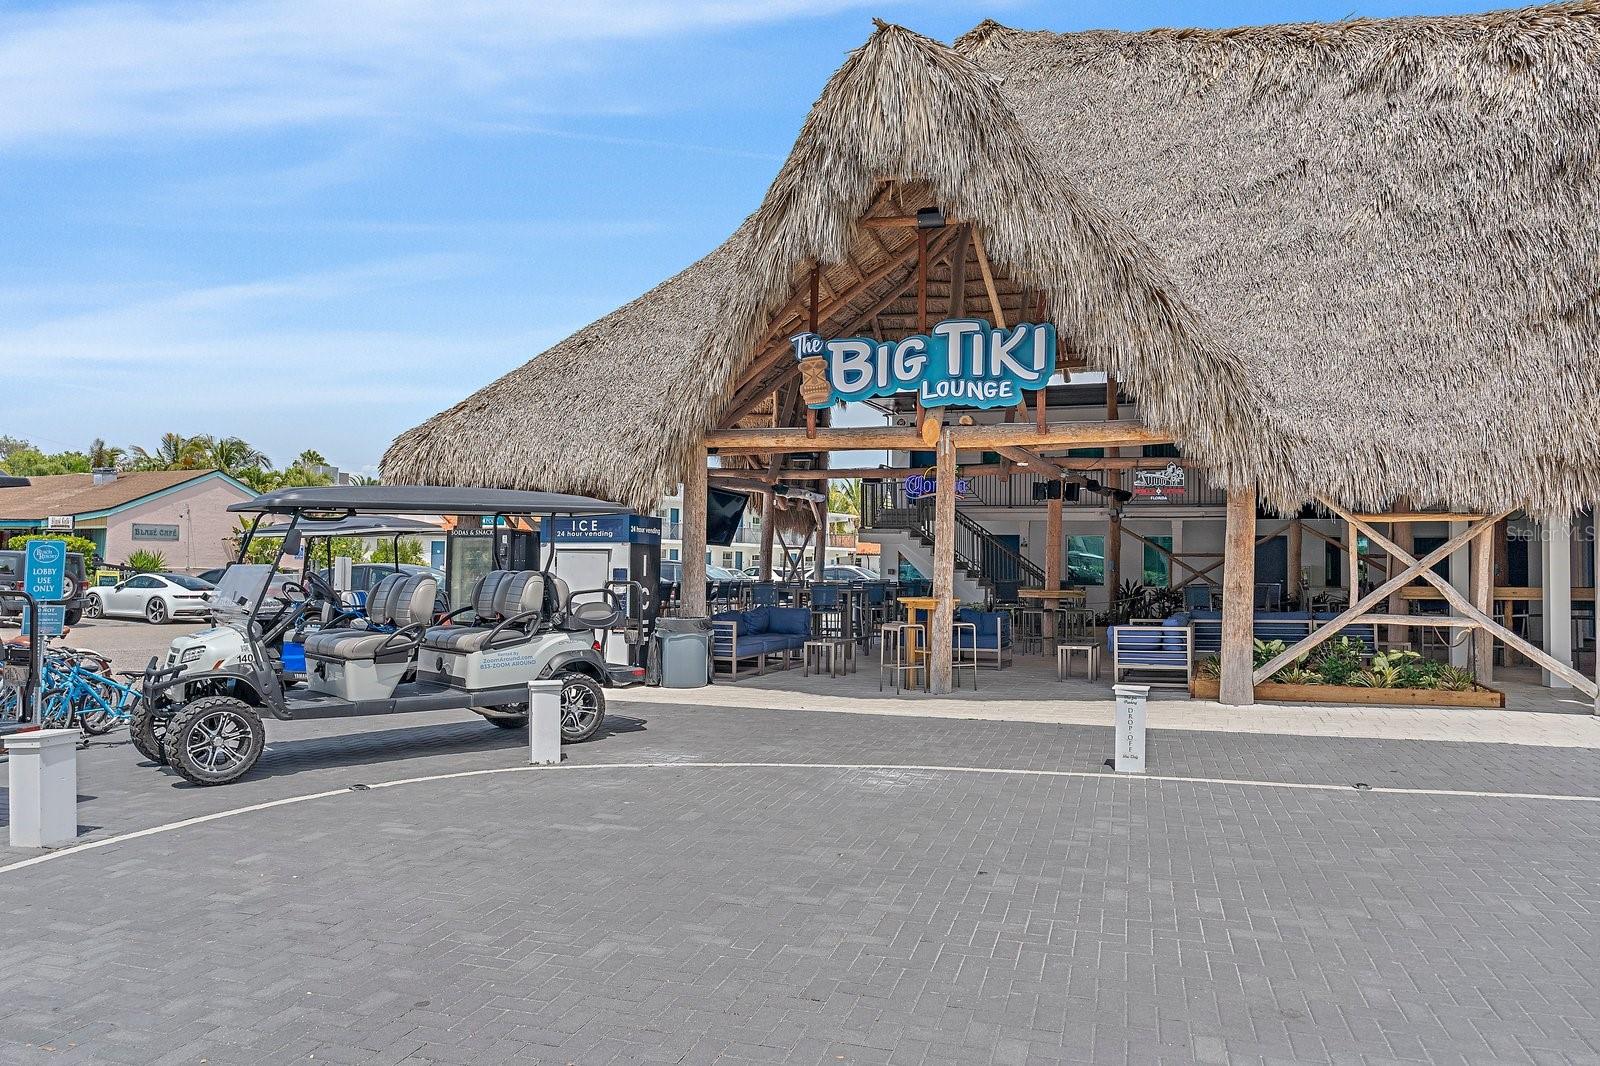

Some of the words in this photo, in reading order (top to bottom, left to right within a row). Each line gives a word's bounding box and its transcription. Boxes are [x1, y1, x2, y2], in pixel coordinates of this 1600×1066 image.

[790, 334, 823, 359] The
[827, 339, 928, 393] BIG
[934, 322, 1046, 380] TIKI
[922, 380, 1013, 400] LOUNGE
[572, 520, 598, 531] ICE
[630, 525, 636, 533] 24
[646, 527, 661, 536] vending
[584, 530, 613, 538] vending
[237, 654, 254, 663] 140
